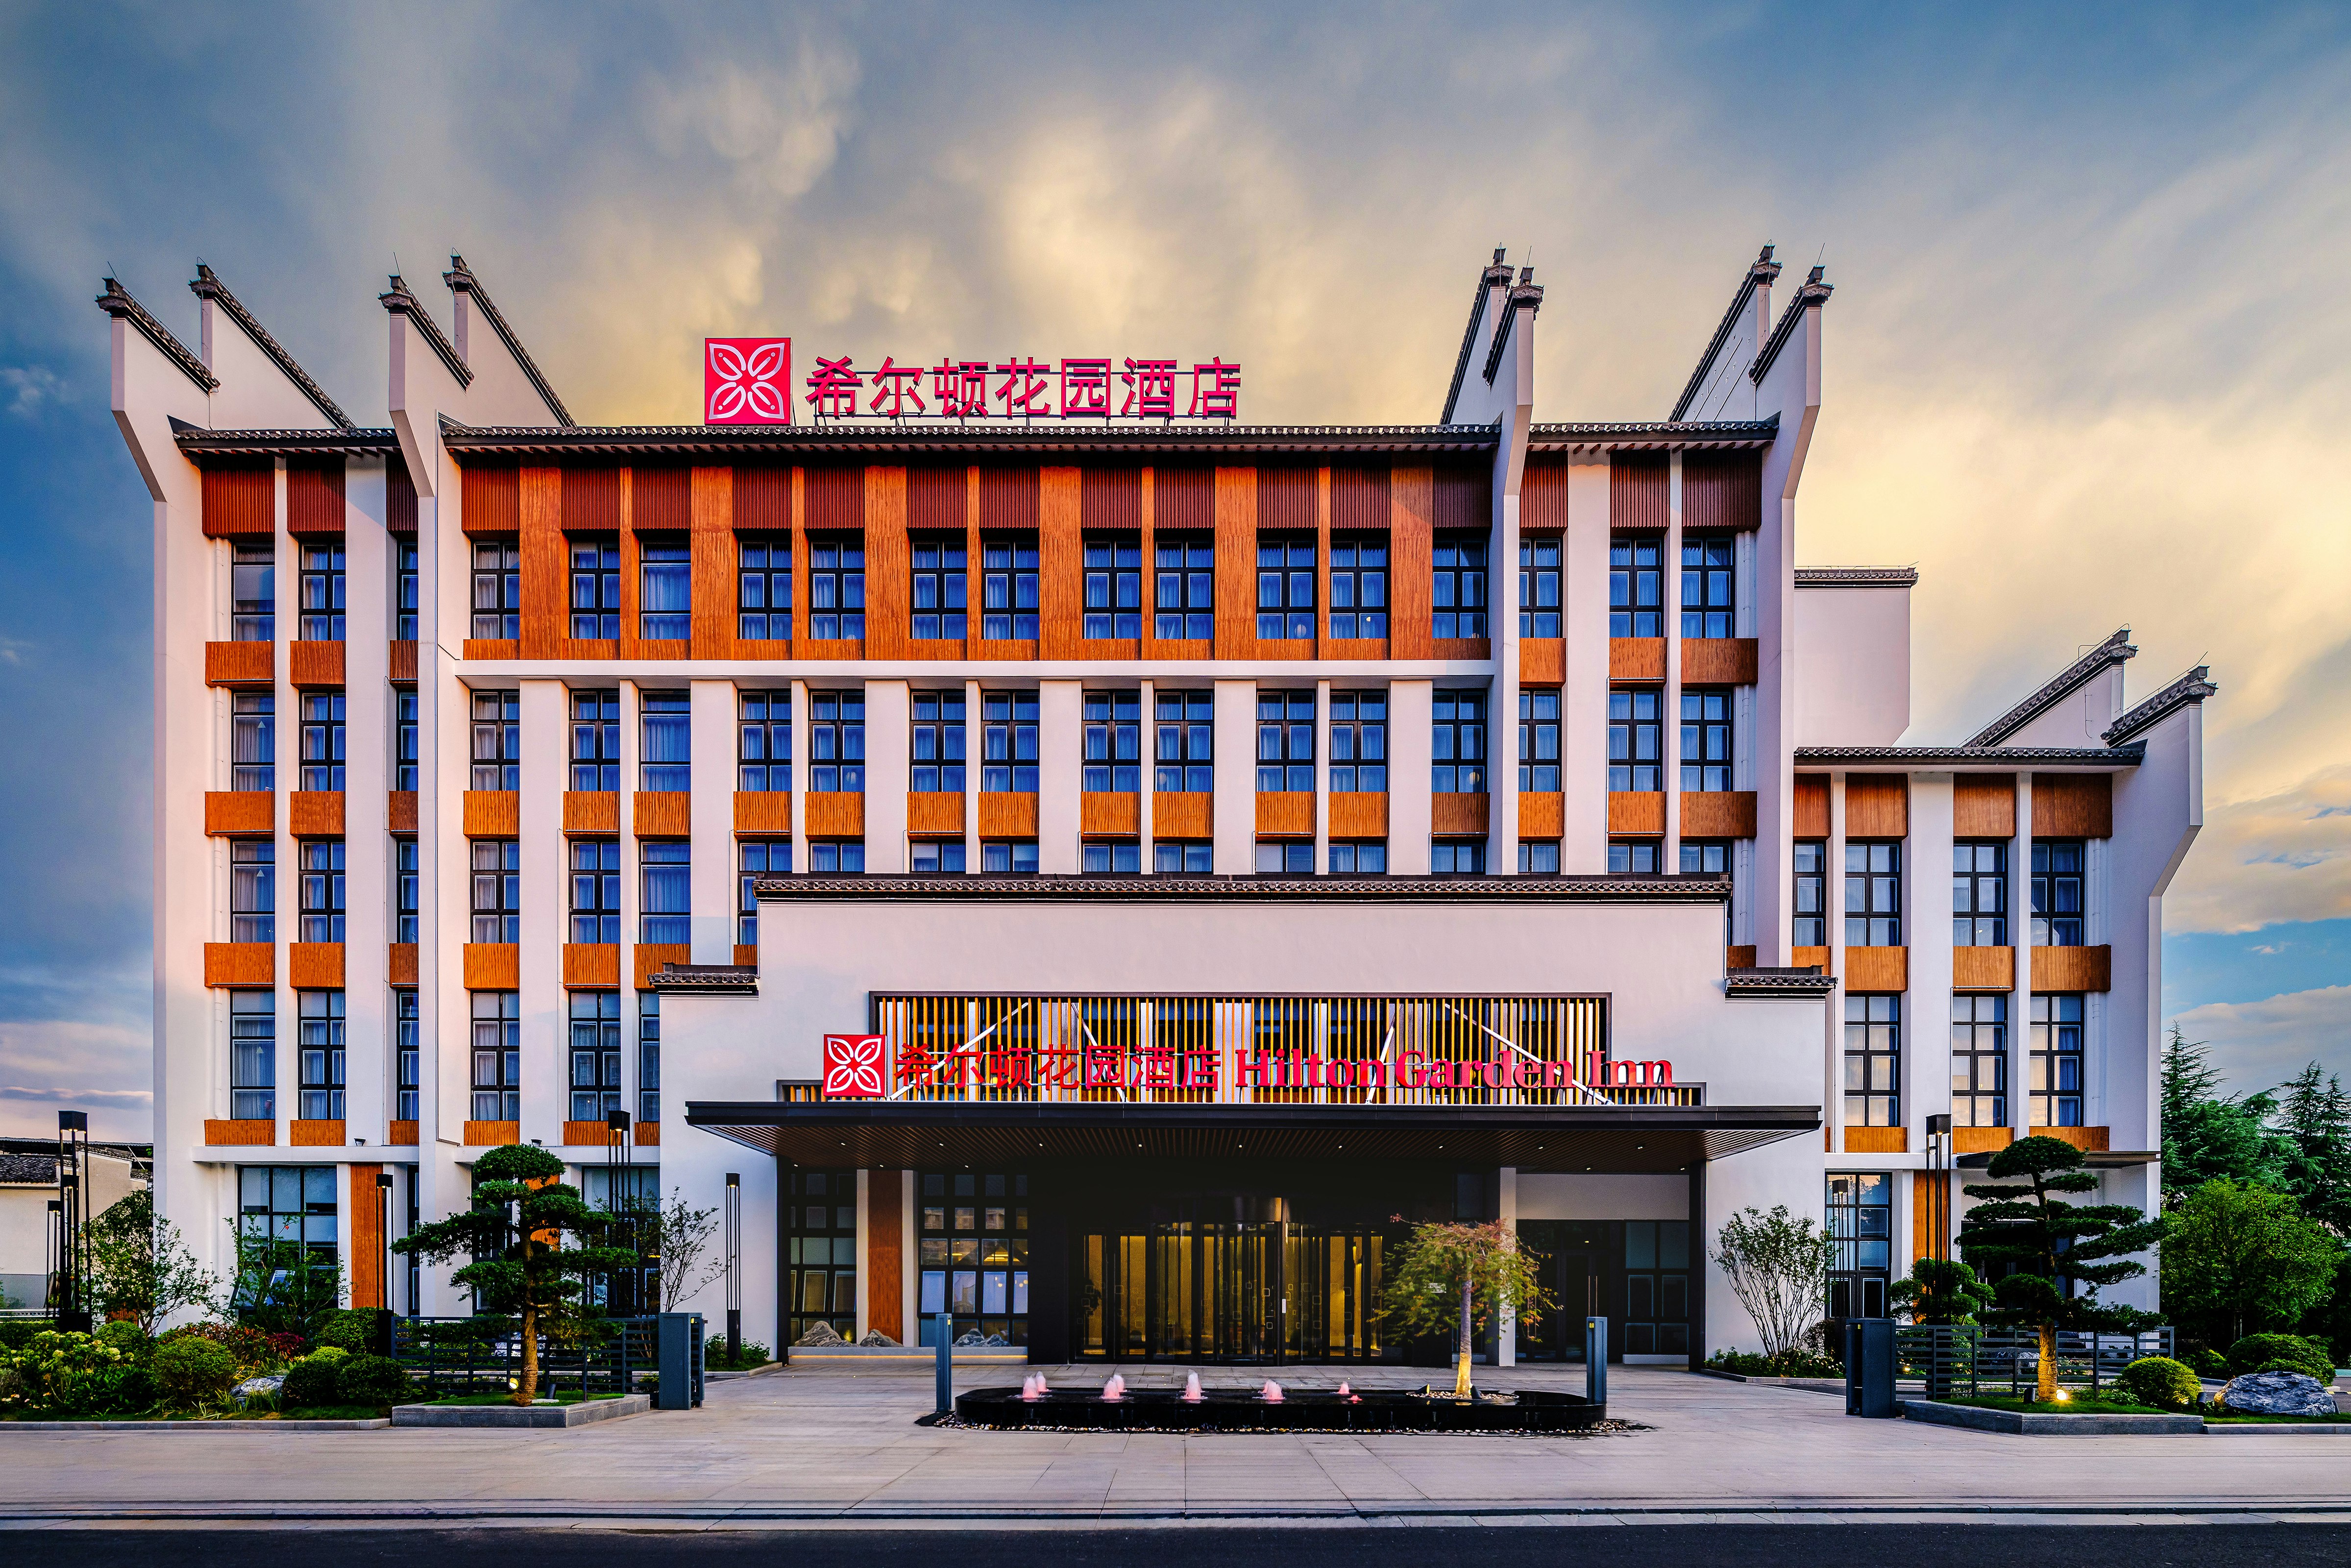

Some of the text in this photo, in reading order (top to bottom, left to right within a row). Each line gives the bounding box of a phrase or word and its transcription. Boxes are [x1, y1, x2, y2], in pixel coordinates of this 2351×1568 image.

[805, 355, 1241, 419] 希尔顿花园酒店
[894, 1043, 1676, 1091] 希尔顿花园酒店 Hilton Garden Inn
